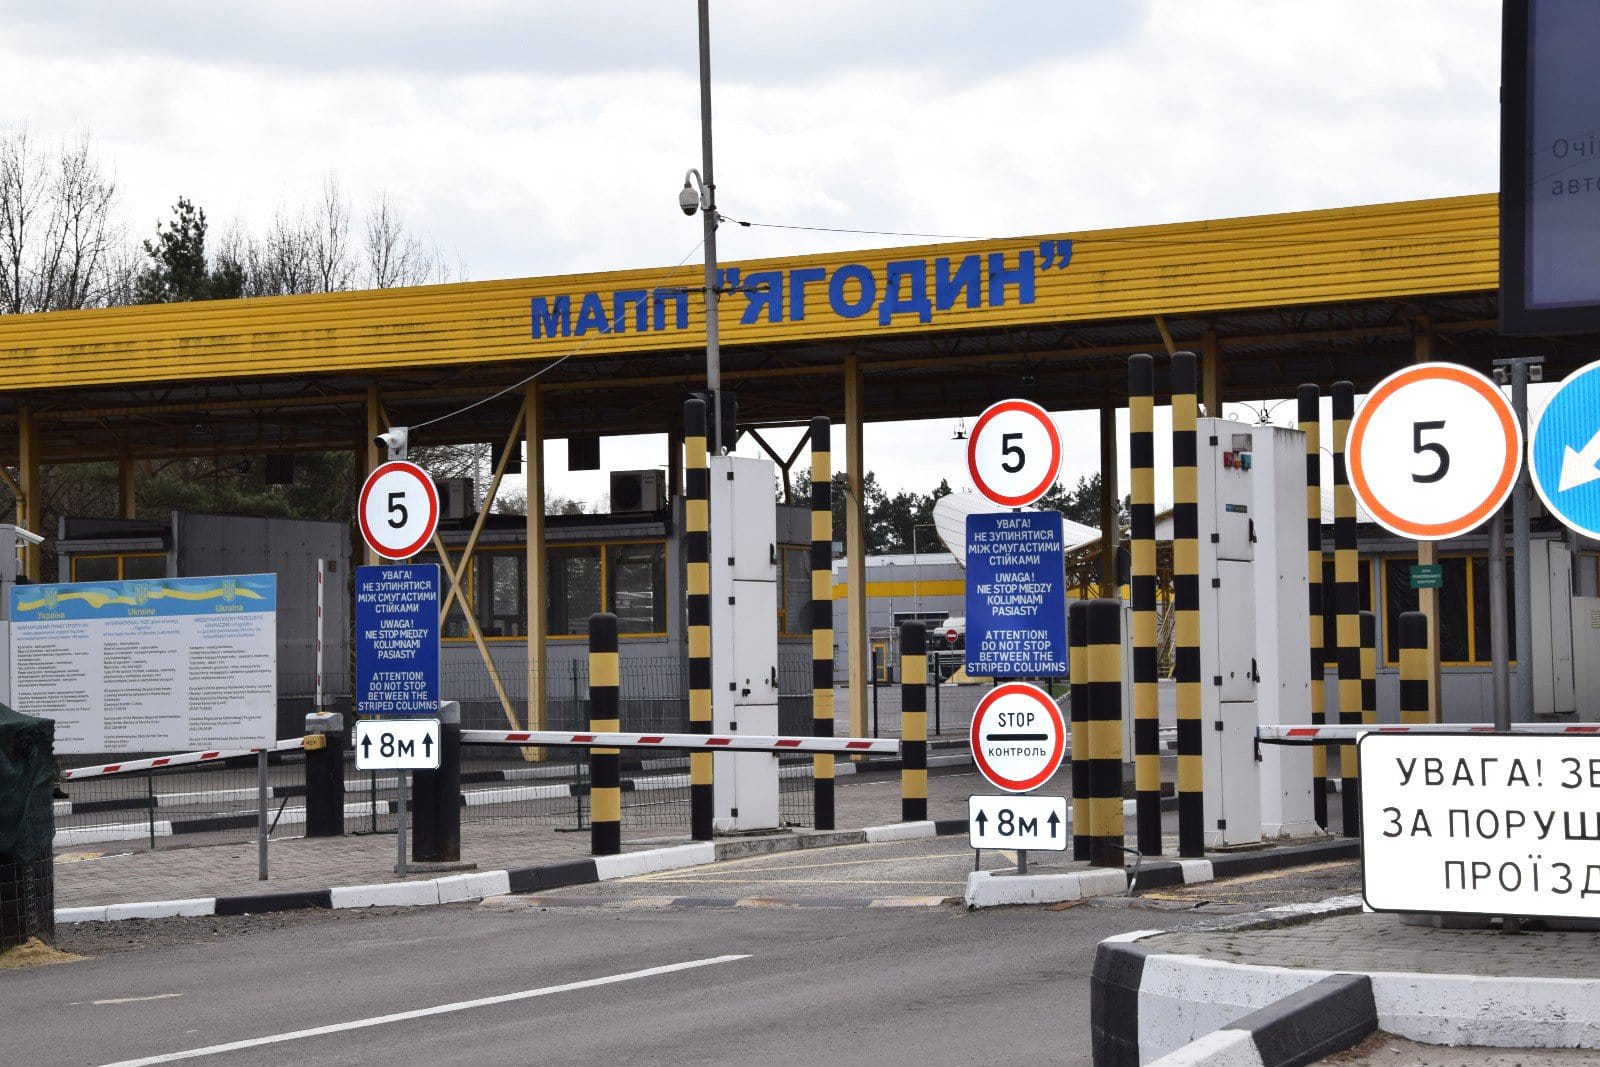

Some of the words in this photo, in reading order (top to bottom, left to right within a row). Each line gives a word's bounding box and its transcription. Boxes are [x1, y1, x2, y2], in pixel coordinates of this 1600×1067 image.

[1552, 135, 1600, 159] Очі
[531, 286, 688, 339] МАПП
[1001, 432, 1026, 474] 5
[1411, 420, 1450, 484] 5
[387, 491, 408, 529] 5
[996, 518, 1031, 529] УВАГА!
[974, 532, 987, 542] НЕ
[989, 530, 1054, 542] ЗУПИНЯТИСЯ
[968, 544, 990, 554] МІЖ
[992, 542, 1060, 553] СМУГАСТИМИ
[989, 554, 1041, 566] СТІЙКАМИ
[382, 570, 412, 580] УВАГА!
[363, 583, 374, 591] НЕ
[375, 581, 431, 592] ЗУПИНЯТИСЯ
[977, 584, 991, 594] NIE
[993, 584, 1017, 594] STOP
[1018, 583, 1052, 595] MIĘDZY
[358, 594, 377, 603] МІЖ
[378, 592, 437, 602] СМУГАСТИМИ
[987, 594, 1043, 605] KOLUMNAMI
[375, 602, 419, 613] СТІЙКАМИ
[992, 605, 1038, 616] PASIASTY
[365, 630, 378, 640] NIE
[379, 630, 399, 639] STOP
[400, 629, 428, 639] MIĘDZY
[985, 629, 1048, 640] ATTENTION!
[373, 639, 421, 649] KOLUMNAMI
[981, 641, 996, 651] DO
[999, 641, 1021, 651] NOT
[1023, 640, 1052, 651] STOP
[378, 650, 416, 659] PASIASTY
[979, 651, 1030, 662] BETWEEN
[1033, 651, 1053, 661] THE
[968, 662, 1011, 672] STRIPED
[1013, 662, 1066, 672] COLUMNS
[373, 671, 424, 681] ATTENTION!
[370, 682, 382, 691] DO
[384, 682, 401, 690] NOT
[403, 682, 426, 691] STOP
[368, 691, 409, 701] BETWEEN
[411, 691, 428, 700] THE
[358, 702, 394, 711] STRIPED
[396, 701, 438, 711] COLUMNS
[998, 712, 1035, 728] STOP
[988, 747, 1046, 757] КОНТРОЛЬ
[1395, 757, 1543, 787] УВАГА!
[1382, 806, 1433, 838] ЗА
[1448, 808, 1600, 841] ПОРУШ
[1444, 854, 1600, 899] ПРОЇЗД
